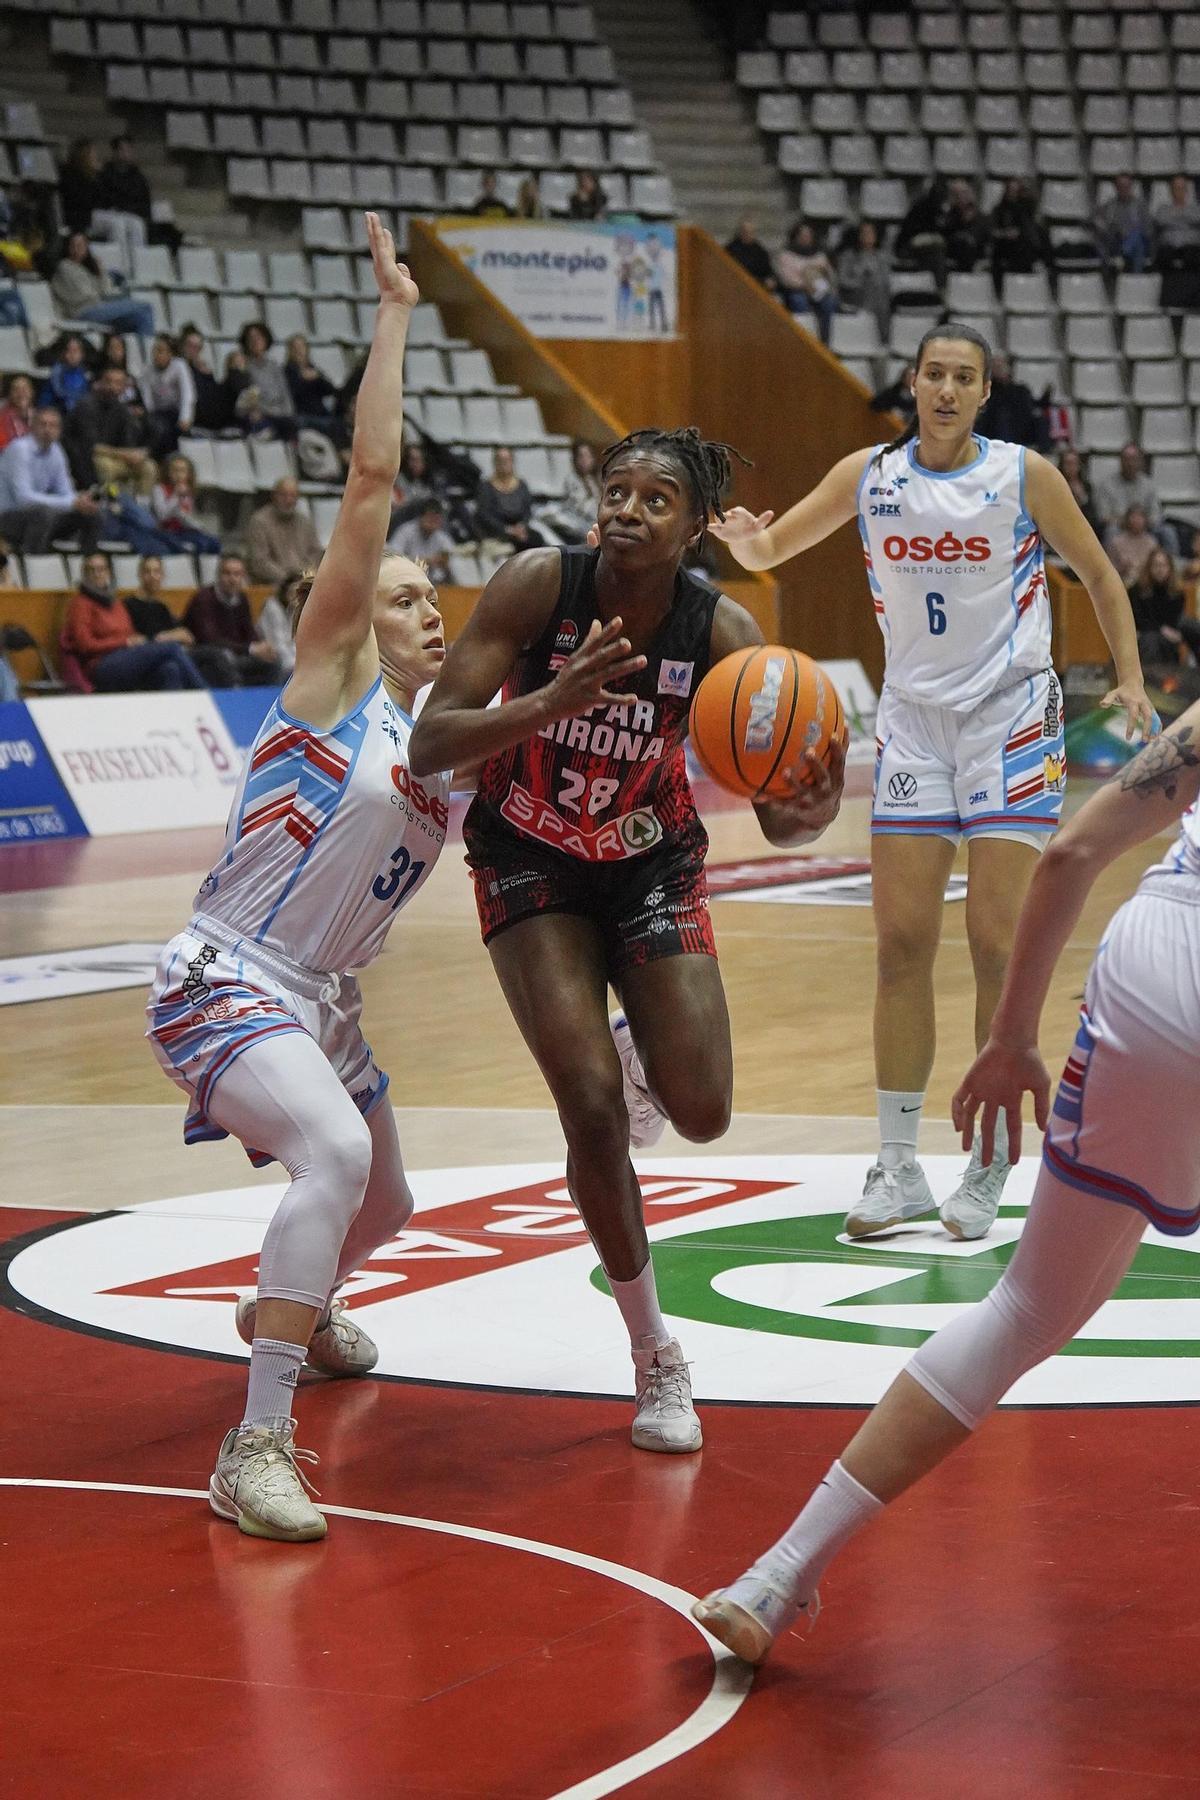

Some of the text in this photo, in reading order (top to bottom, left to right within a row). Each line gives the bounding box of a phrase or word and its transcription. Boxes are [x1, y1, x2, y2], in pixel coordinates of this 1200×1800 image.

[482, 246, 608, 275] montepio
[890, 564, 986, 575] CONSTRUCCIÓN
[925, 591, 947, 636] 6
[584, 699, 655, 733] AR
[62, 745, 185, 786] FRISELVA
[557, 766, 620, 817] 28
[390, 794, 446, 844] CONSTRUC
[508, 791, 621, 859] SPAR
[371, 845, 427, 910] 31
